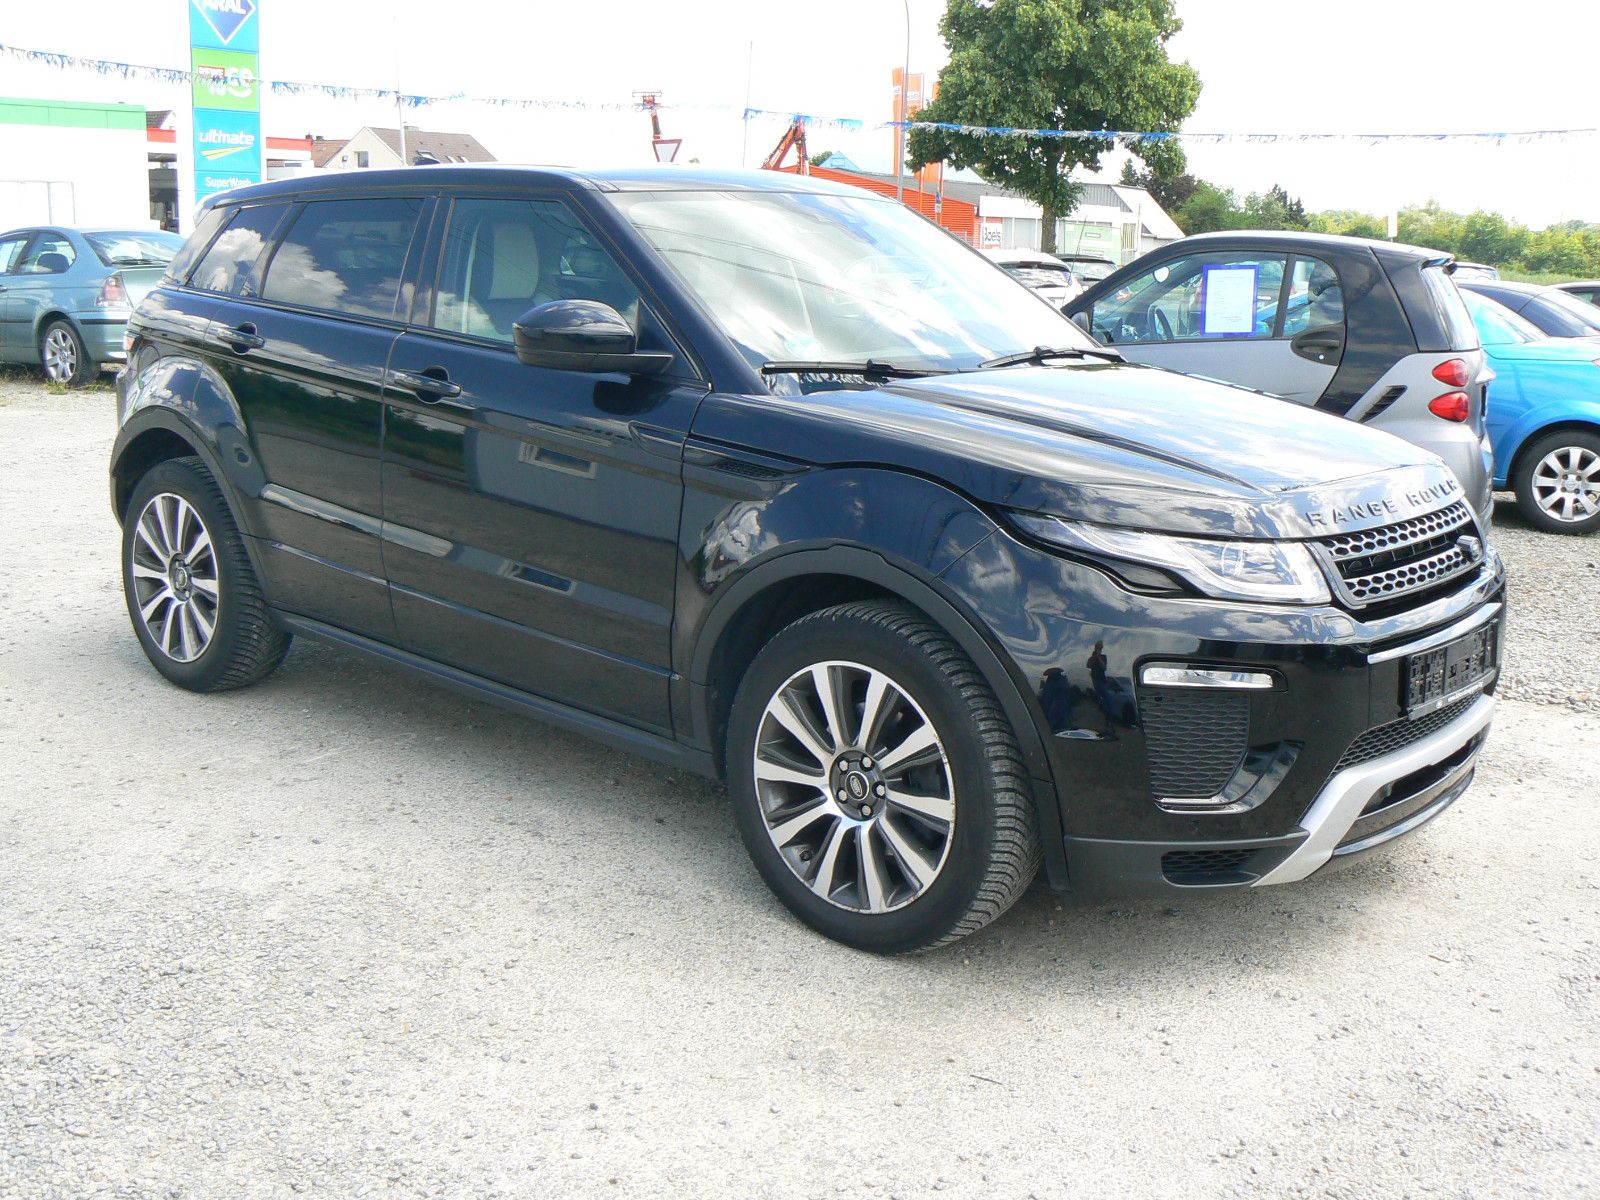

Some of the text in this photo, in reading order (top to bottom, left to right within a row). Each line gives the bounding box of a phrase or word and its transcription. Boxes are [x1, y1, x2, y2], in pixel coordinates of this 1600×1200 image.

[202, 0, 246, 14] ARAL
[199, 128, 255, 145] ultimate
[206, 176, 252, 188] SuperWash
[1305, 479, 1458, 527] RANGE ROVER
